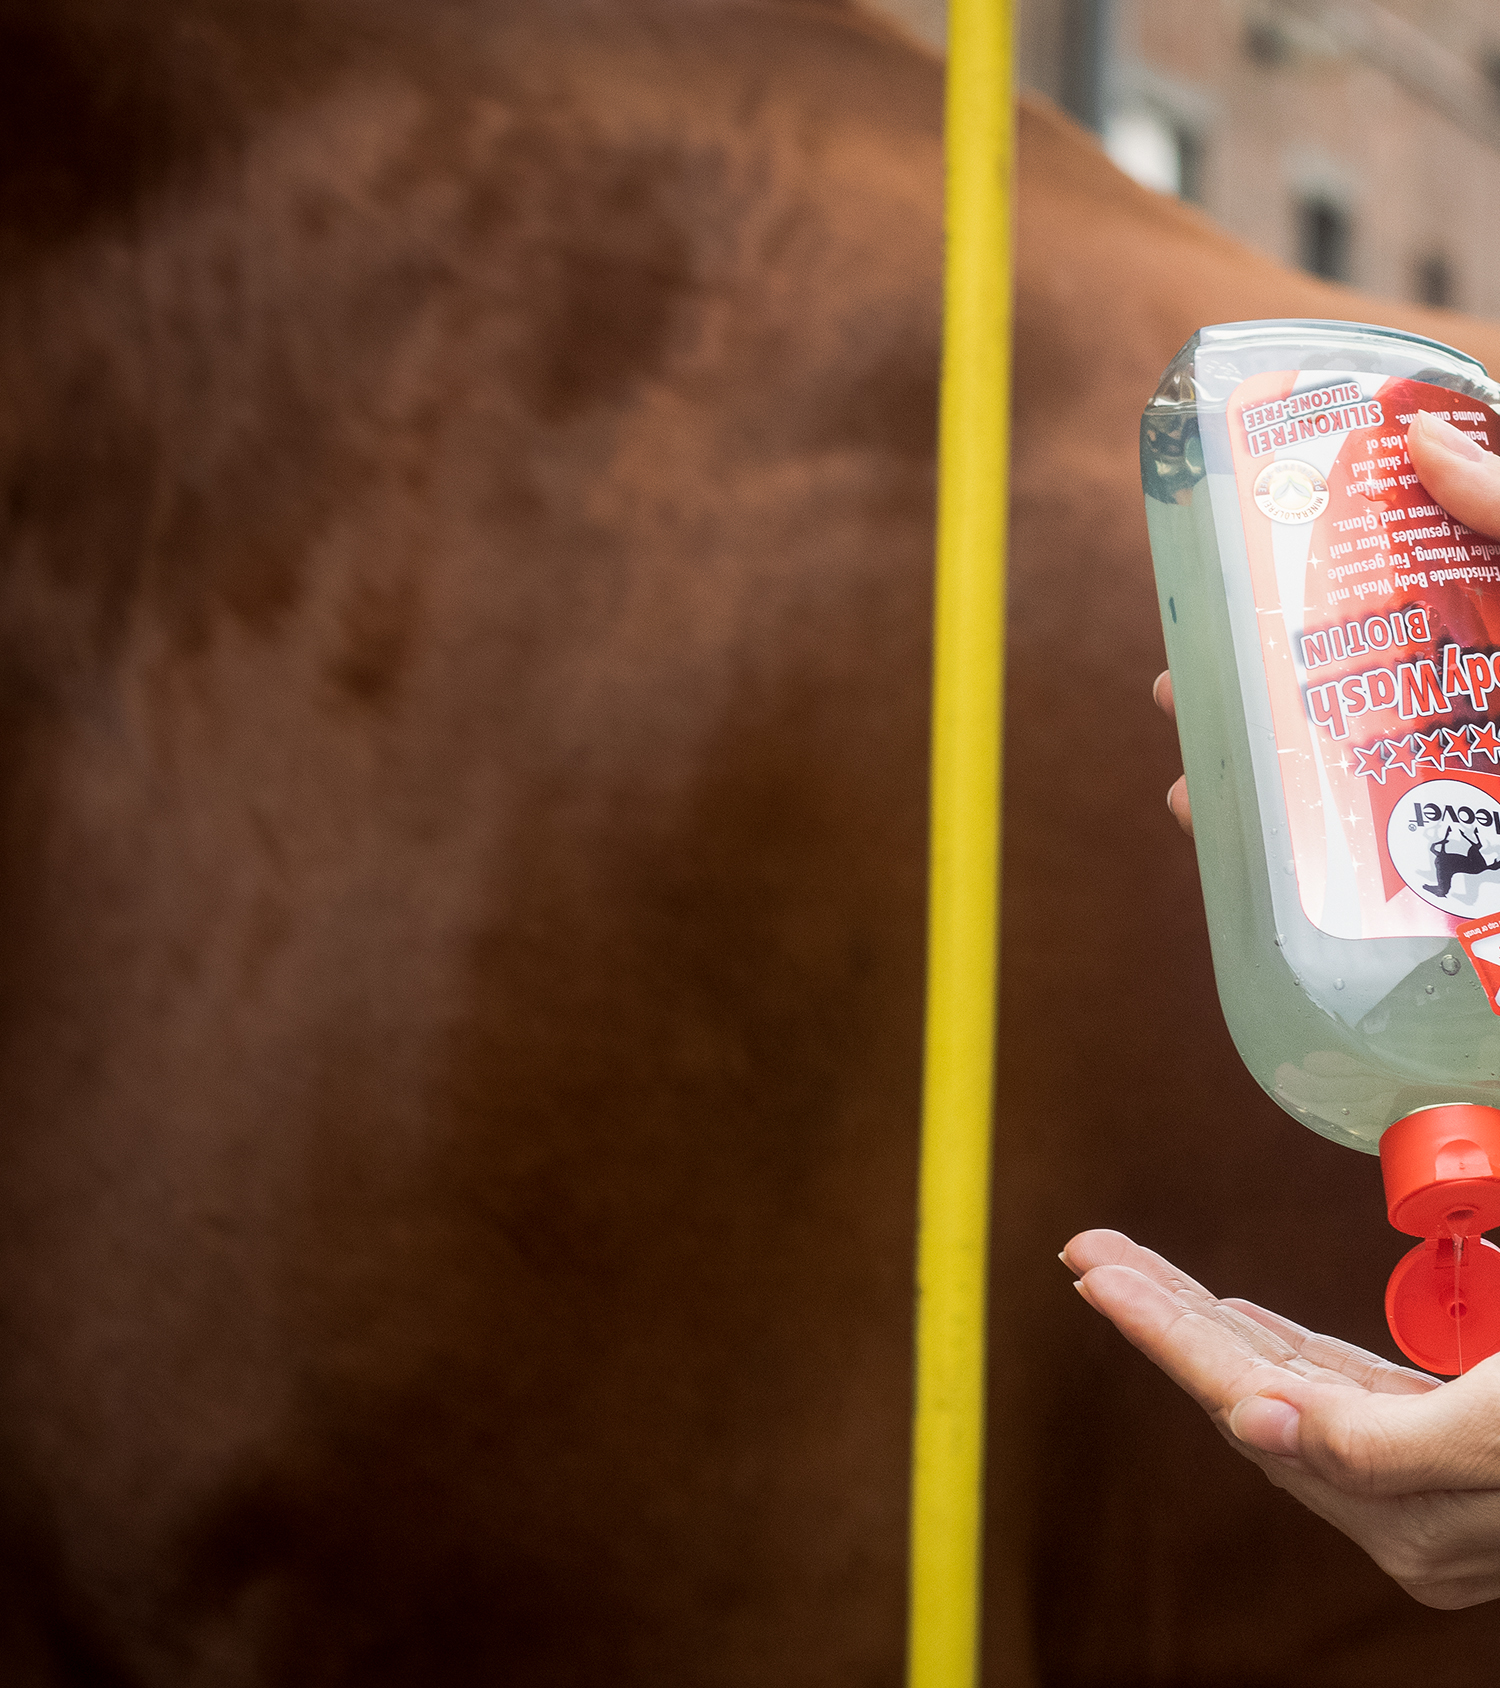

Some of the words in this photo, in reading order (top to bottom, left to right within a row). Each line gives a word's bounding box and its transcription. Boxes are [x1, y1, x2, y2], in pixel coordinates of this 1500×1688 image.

[1245, 385, 1360, 430] SILICONE-FREE
[1452, 411, 1487, 426] volume
[1249, 402, 1382, 456] SILIKONFREI
[1366, 439, 1379, 455] of
[1380, 435, 1404, 450] lots
[1351, 460, 1375, 478] and
[1377, 455, 1402, 471] skin
[1346, 480, 1371, 498] fast
[1372, 477, 1397, 495] with
[1398, 474, 1419, 490] ash
[1332, 514, 1378, 532] Glanz.
[1380, 508, 1406, 529] und
[1391, 521, 1451, 547] gesundes
[1452, 525, 1472, 541] nd
[1329, 541, 1353, 560] mit
[1355, 534, 1391, 551] Haar
[1389, 552, 1411, 569] Für
[1411, 546, 1470, 564] Wirkung.
[1327, 553, 1386, 583] gesunde
[1352, 578, 1394, 600] Wash
[1394, 572, 1429, 592] Body
[1326, 587, 1350, 606] mit
[1299, 608, 1431, 670] BIOTIN
